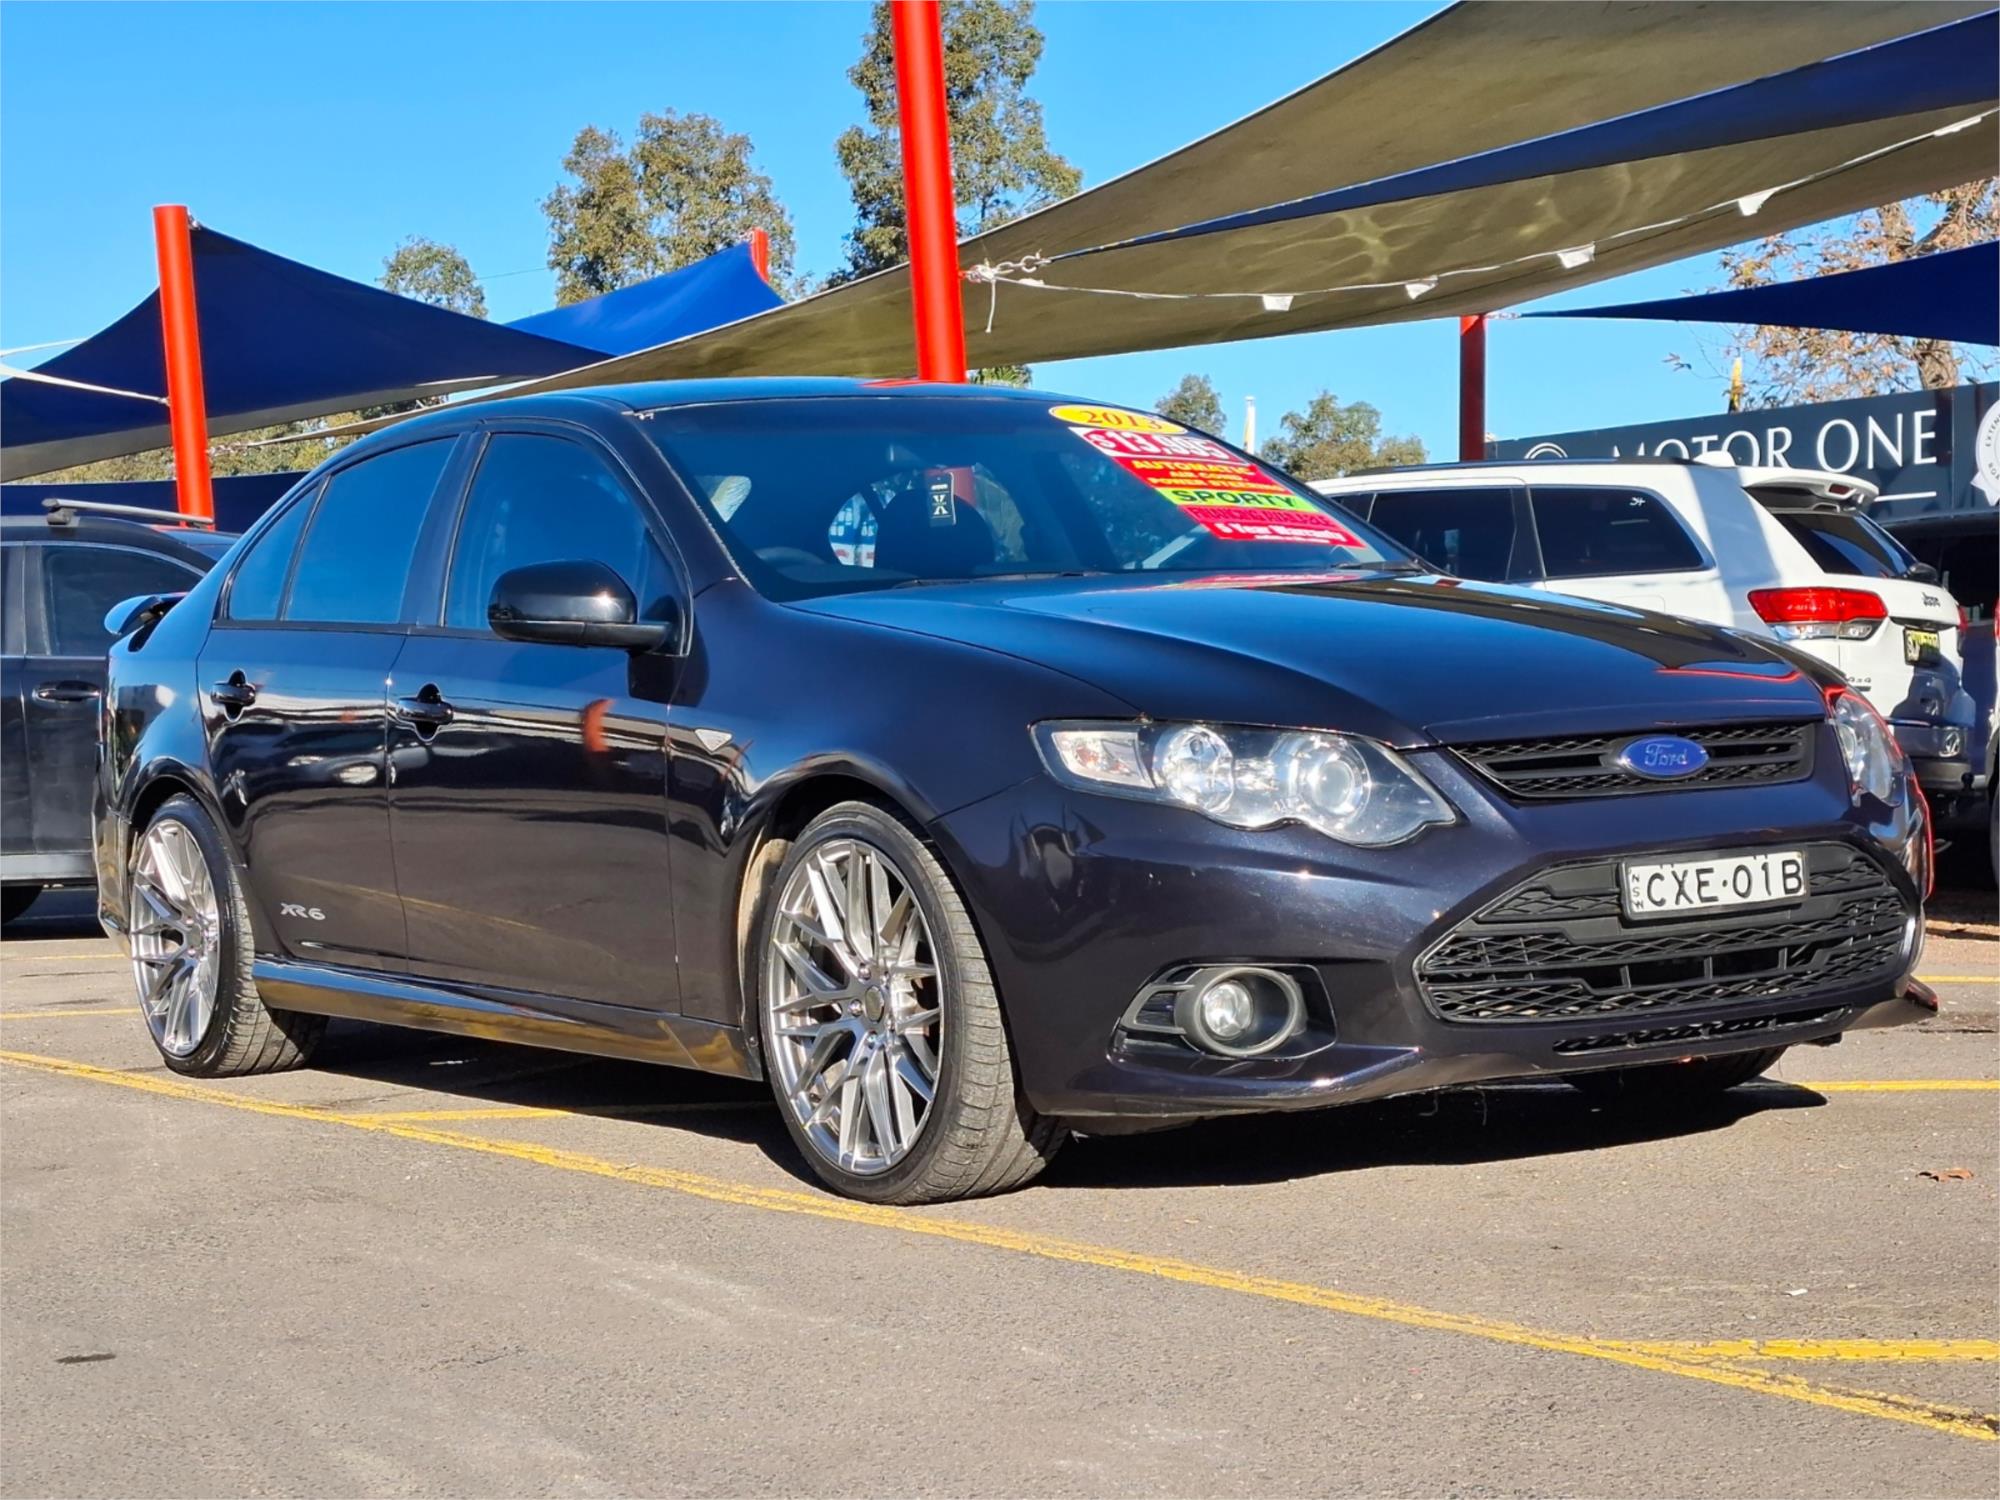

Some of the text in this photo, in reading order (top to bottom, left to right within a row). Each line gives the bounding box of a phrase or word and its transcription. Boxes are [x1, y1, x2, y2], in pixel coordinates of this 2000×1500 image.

[1613, 409, 1937, 473] OTOR ONE
[1172, 490, 1294, 508] SPORTY
[1644, 743, 1688, 767] Ford
[280, 902, 326, 921] XR6
